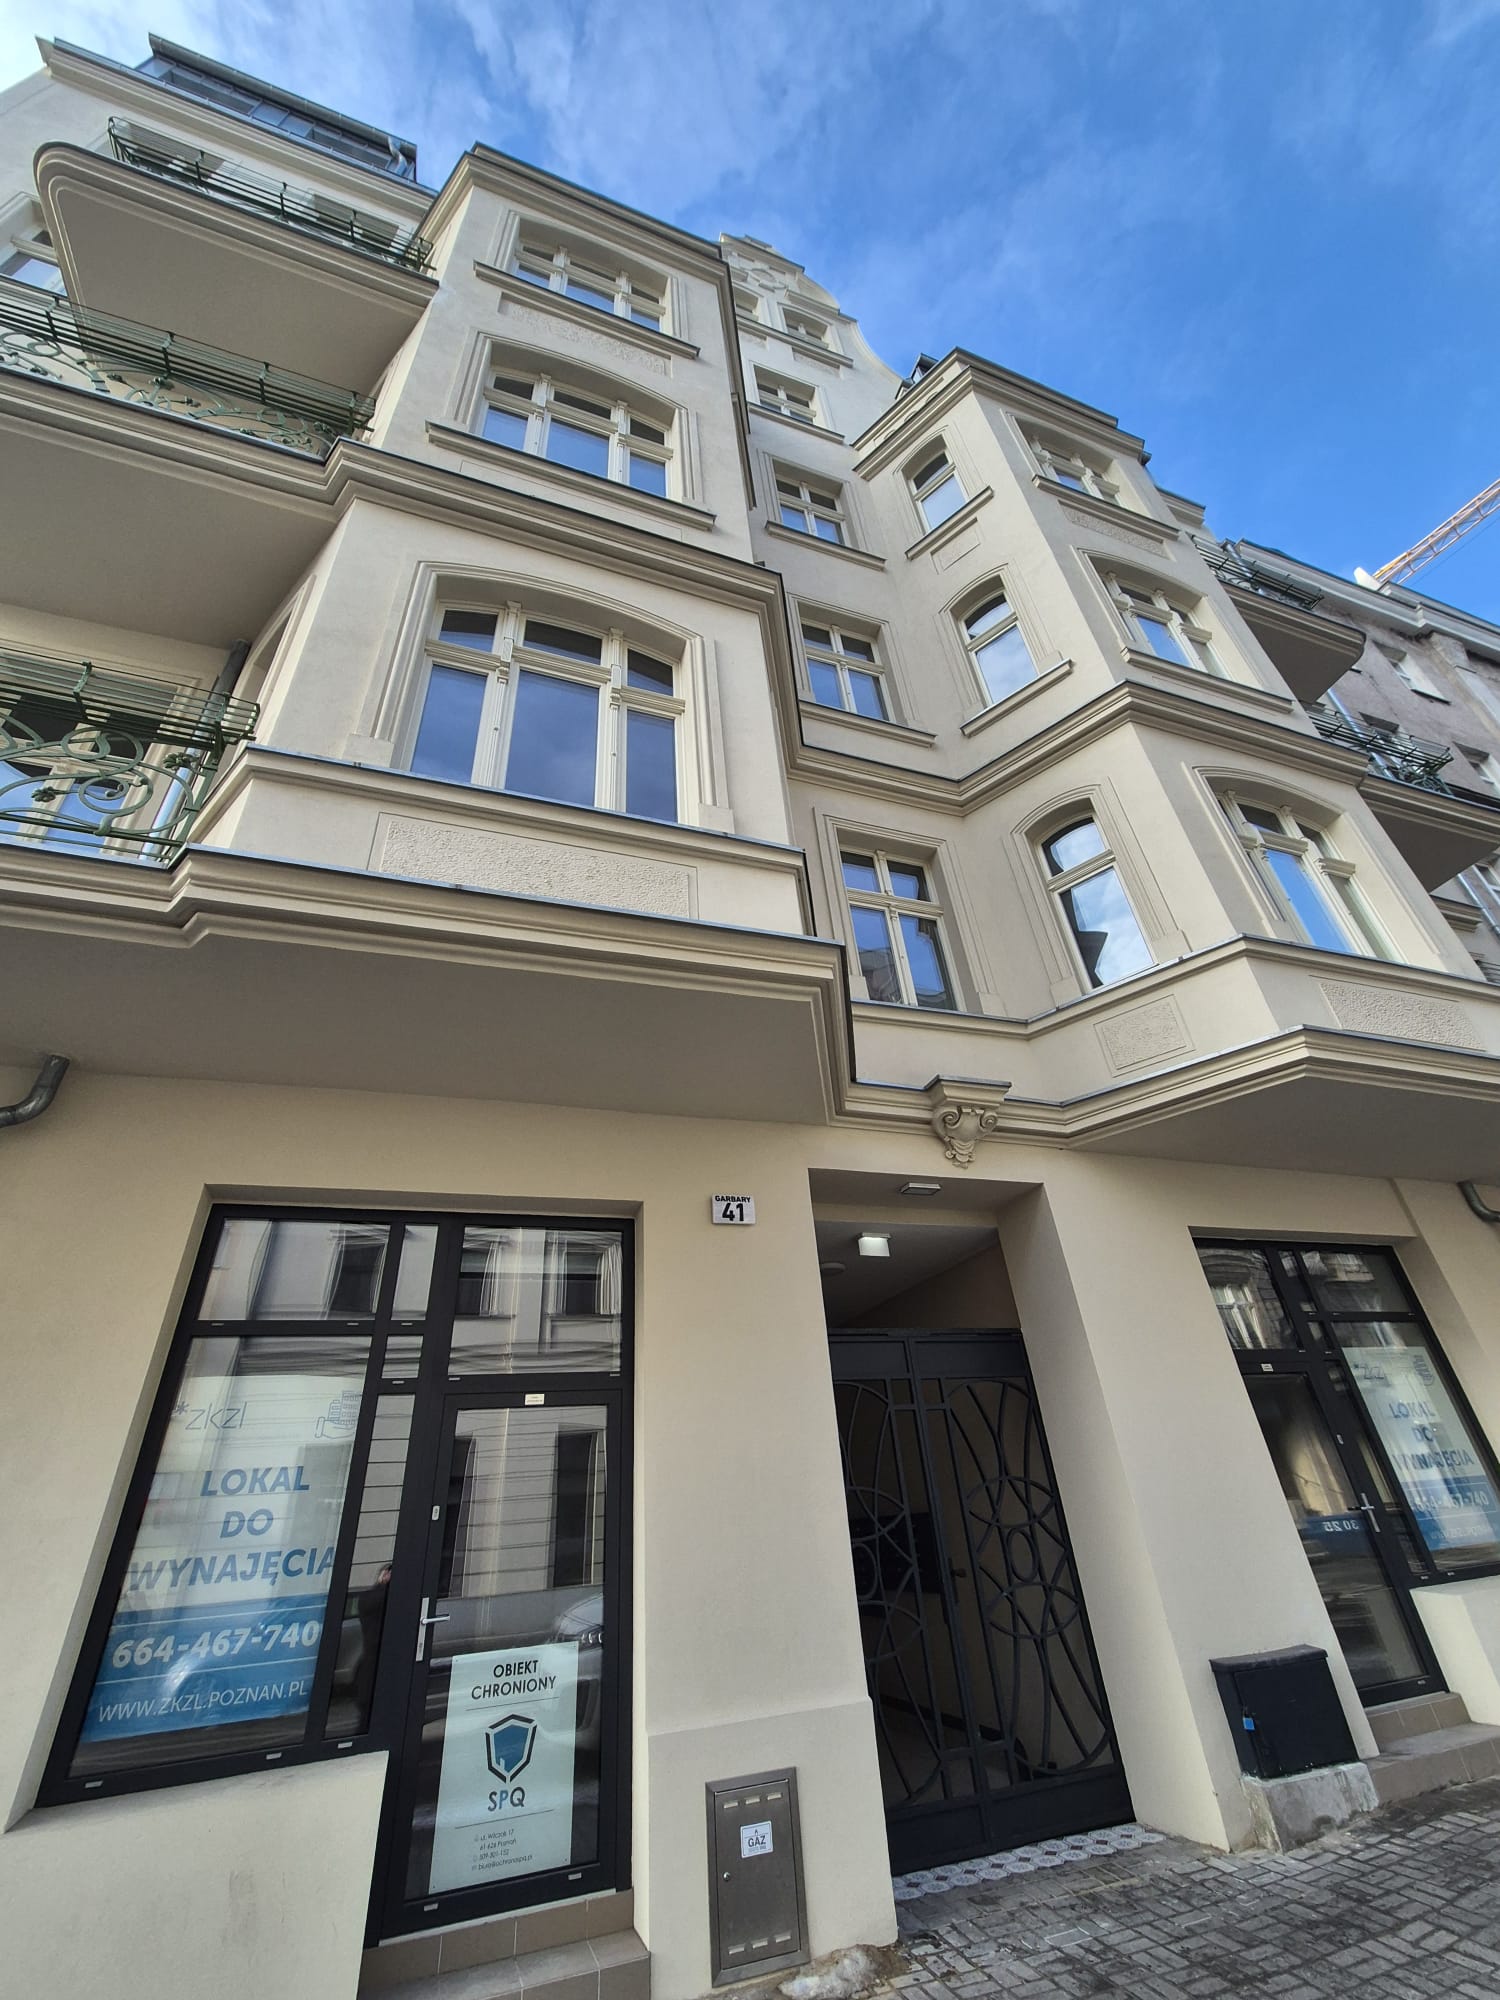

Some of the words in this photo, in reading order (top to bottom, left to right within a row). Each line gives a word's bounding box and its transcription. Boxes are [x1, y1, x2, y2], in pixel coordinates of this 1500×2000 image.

[715, 1195, 751, 1203] GARBARY
[722, 1202, 744, 1221] 41
[200, 1465, 311, 1497] LOKAL
[219, 1508, 274, 1538] DO
[129, 1545, 336, 1592] WYNAJĘCIA
[111, 1620, 321, 1668] 664-467-740
[493, 1659, 539, 1678] OBIEKT
[471, 1676, 557, 1700] CHRONIONY
[99, 1680, 308, 1723] WWW.ZKZL.POZNAN.PL
[487, 1786, 527, 1812] SPQ
[748, 1835, 766, 1847] GAZ
